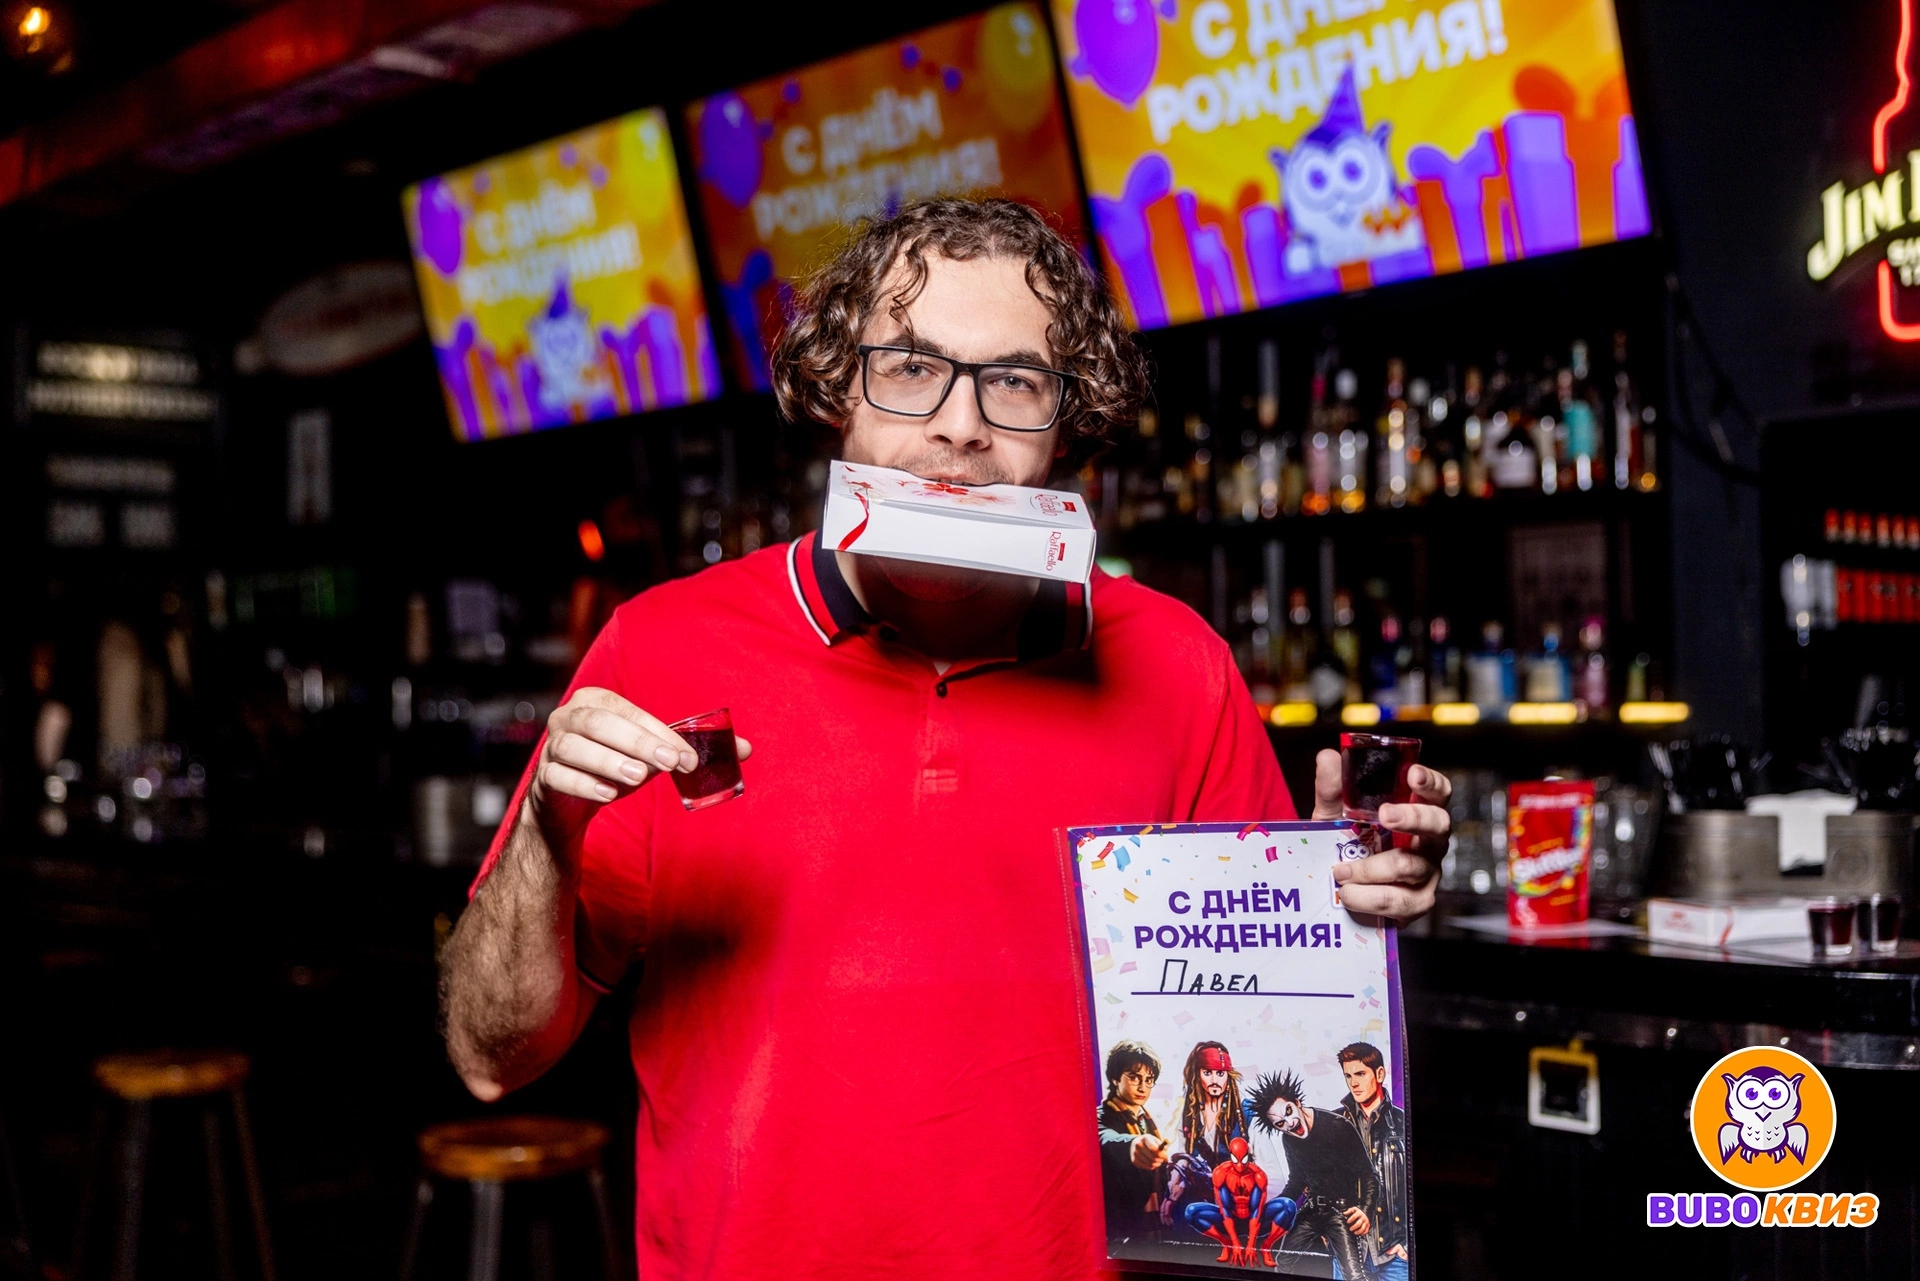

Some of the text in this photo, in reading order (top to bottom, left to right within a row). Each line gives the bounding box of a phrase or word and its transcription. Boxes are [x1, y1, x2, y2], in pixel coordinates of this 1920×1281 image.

[1191, 0, 1236, 59] С
[1146, 0, 1508, 143] РОЖДЕНИЯ!
[782, 87, 943, 176] С ДНЁМ
[1807, 169, 1905, 281] JIM
[1046, 530, 1062, 572] Raffaello
[1168, 890, 1192, 915] С
[1202, 882, 1300, 919] ДНЁМ
[1134, 923, 1342, 953] РОЖДЕНИЯ!
